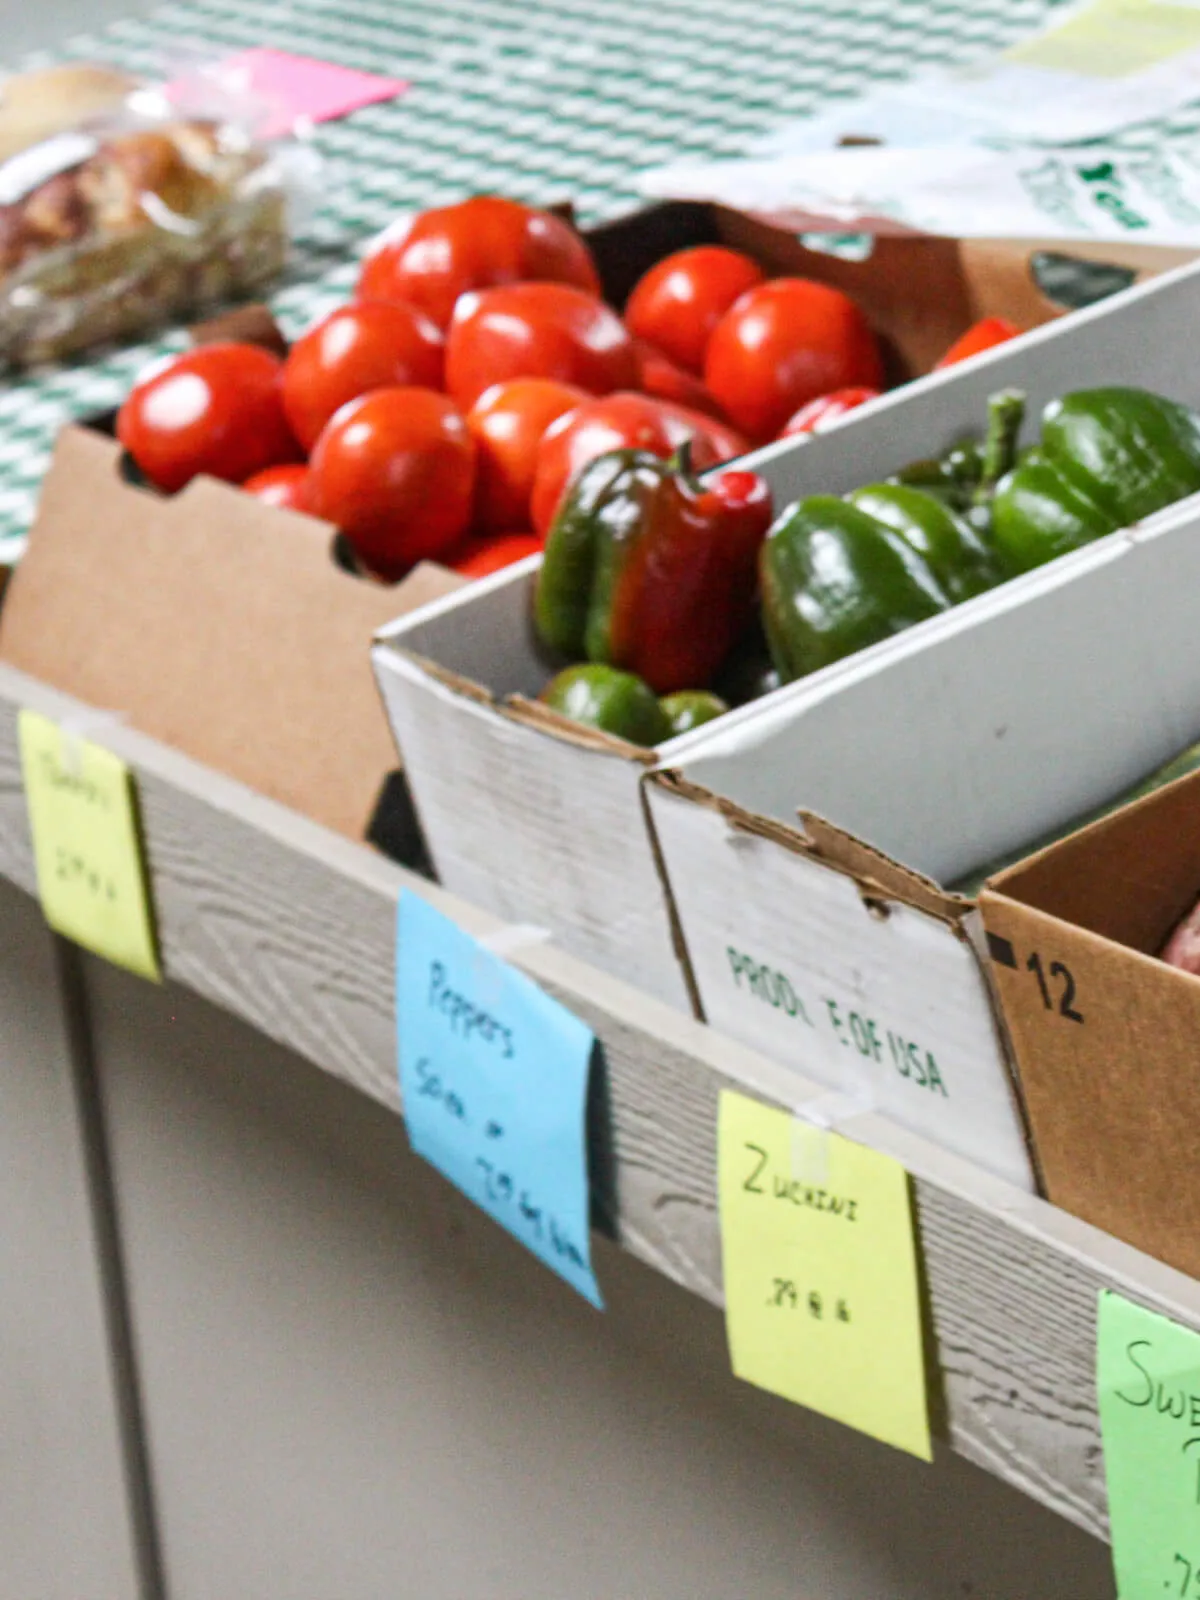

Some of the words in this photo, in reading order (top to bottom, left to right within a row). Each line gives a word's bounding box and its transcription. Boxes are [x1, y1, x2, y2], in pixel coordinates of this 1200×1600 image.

[1027, 952, 1085, 1025] 12
[849, 1011, 882, 1063] OF
[886, 1030, 949, 1098] USA
